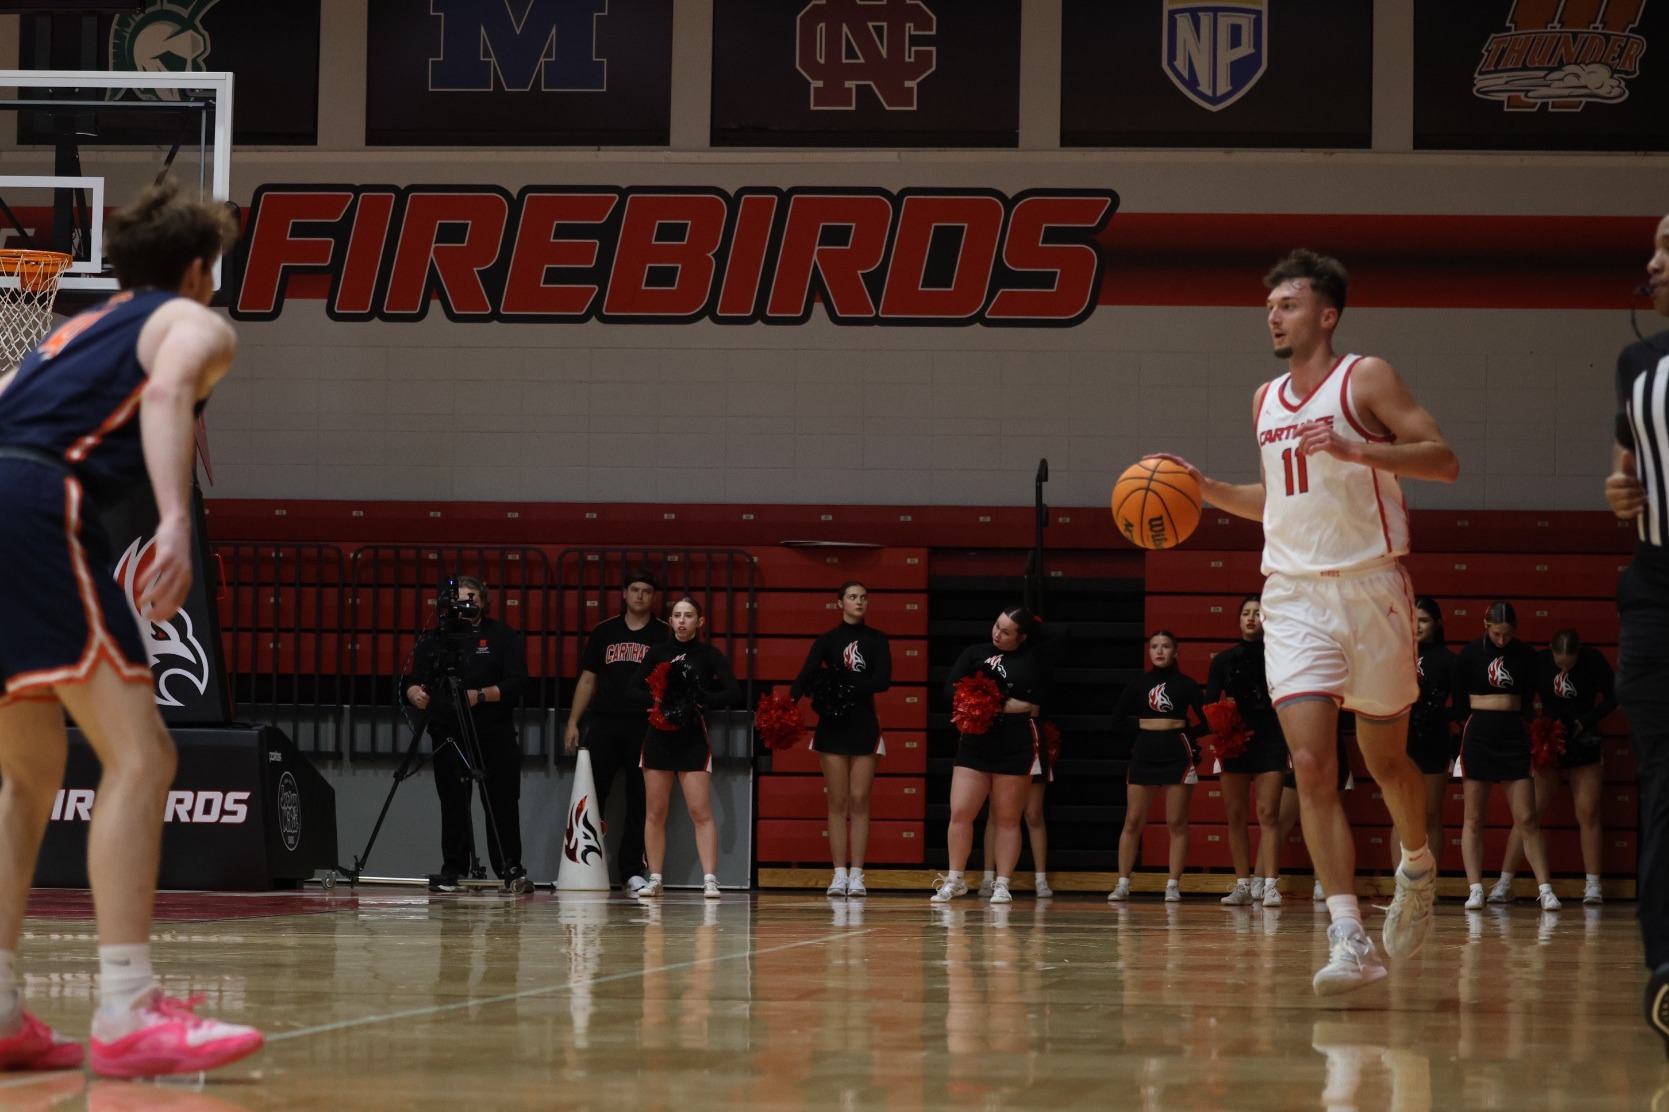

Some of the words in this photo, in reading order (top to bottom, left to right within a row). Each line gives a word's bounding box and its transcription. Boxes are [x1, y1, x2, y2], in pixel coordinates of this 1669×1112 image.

[1173, 7, 1256, 98] NP
[1481, 31, 1645, 74] THUNDER
[234, 187, 1115, 324] FIREBIRDS
[1259, 415, 1335, 447] CARTE
[1282, 446, 1309, 497] 11
[605, 642, 651, 665] CARTHA
